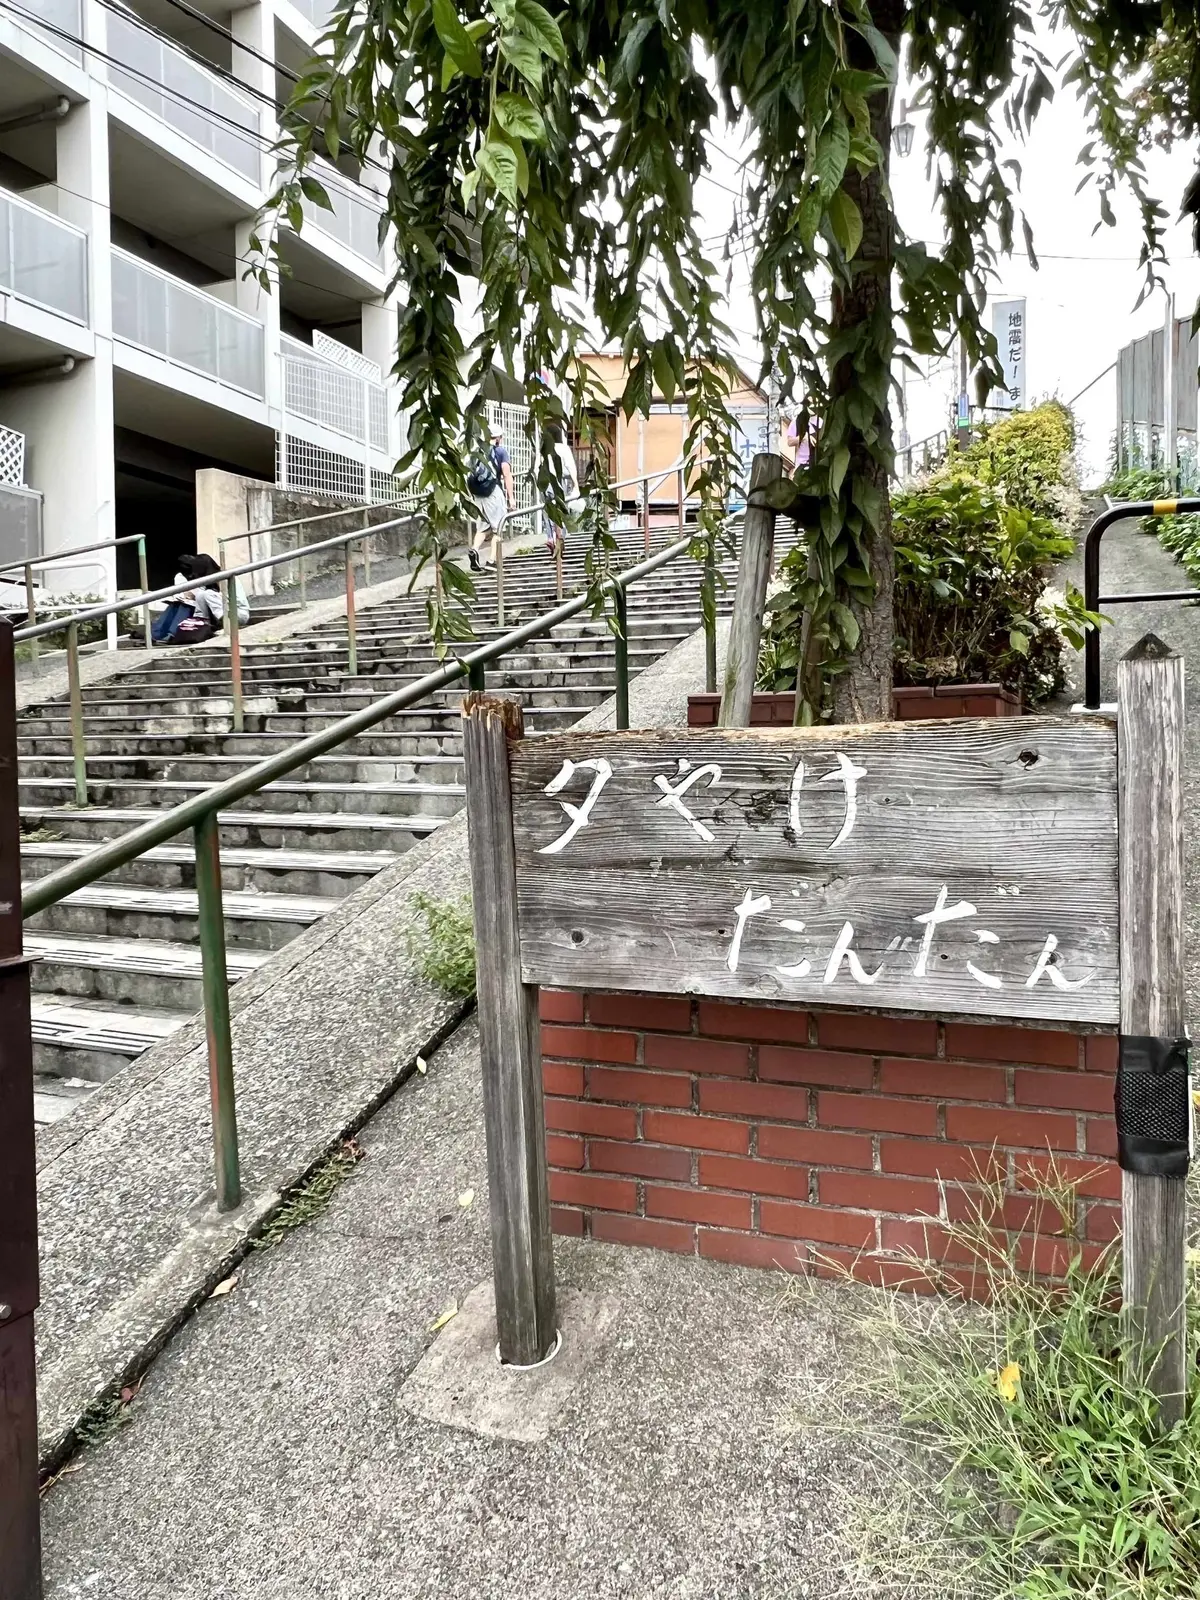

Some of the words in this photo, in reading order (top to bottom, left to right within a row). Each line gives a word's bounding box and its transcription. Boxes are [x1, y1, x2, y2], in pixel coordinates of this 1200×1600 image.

[1008, 311, 1022, 408] 地震だ！ま
[536, 750, 868, 854] 夕やけ
[727, 882, 1098, 990] だんだん
